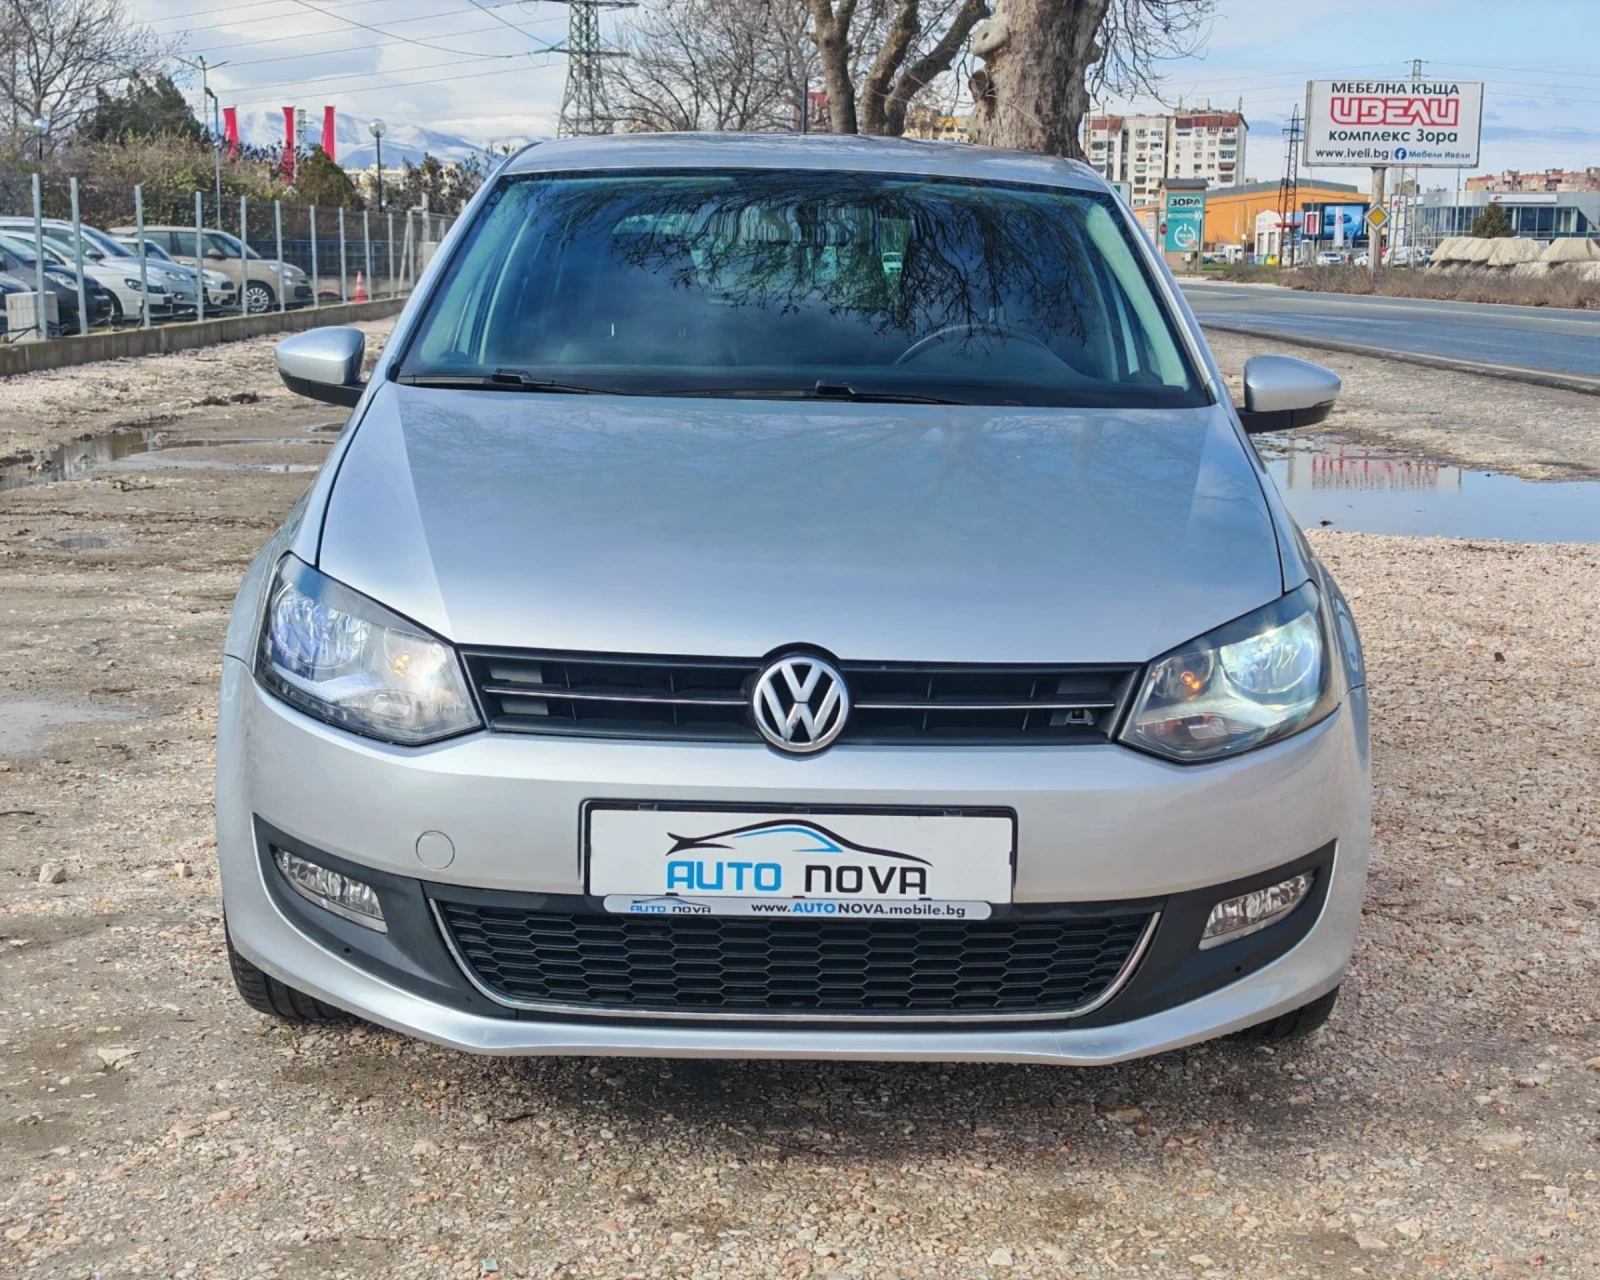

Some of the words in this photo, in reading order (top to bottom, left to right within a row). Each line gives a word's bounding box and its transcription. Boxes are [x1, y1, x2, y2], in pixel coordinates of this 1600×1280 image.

[1331, 82, 1407, 94] МЕБЕЛНА
[1411, 83, 1459, 96] КЪЩА
[1330, 97, 1459, 126] ИВЕЛИ
[1328, 129, 1410, 142] комплекс
[1416, 128, 1458, 145] Зора
[1315, 148, 1389, 160] www.iveli.bg
[1408, 150, 1443, 159] Мебели
[1170, 197, 1202, 207] ЗОРА
[666, 860, 782, 892] AUTO
[804, 864, 927, 895] NOVA
[630, 904, 666, 913] AUTO
